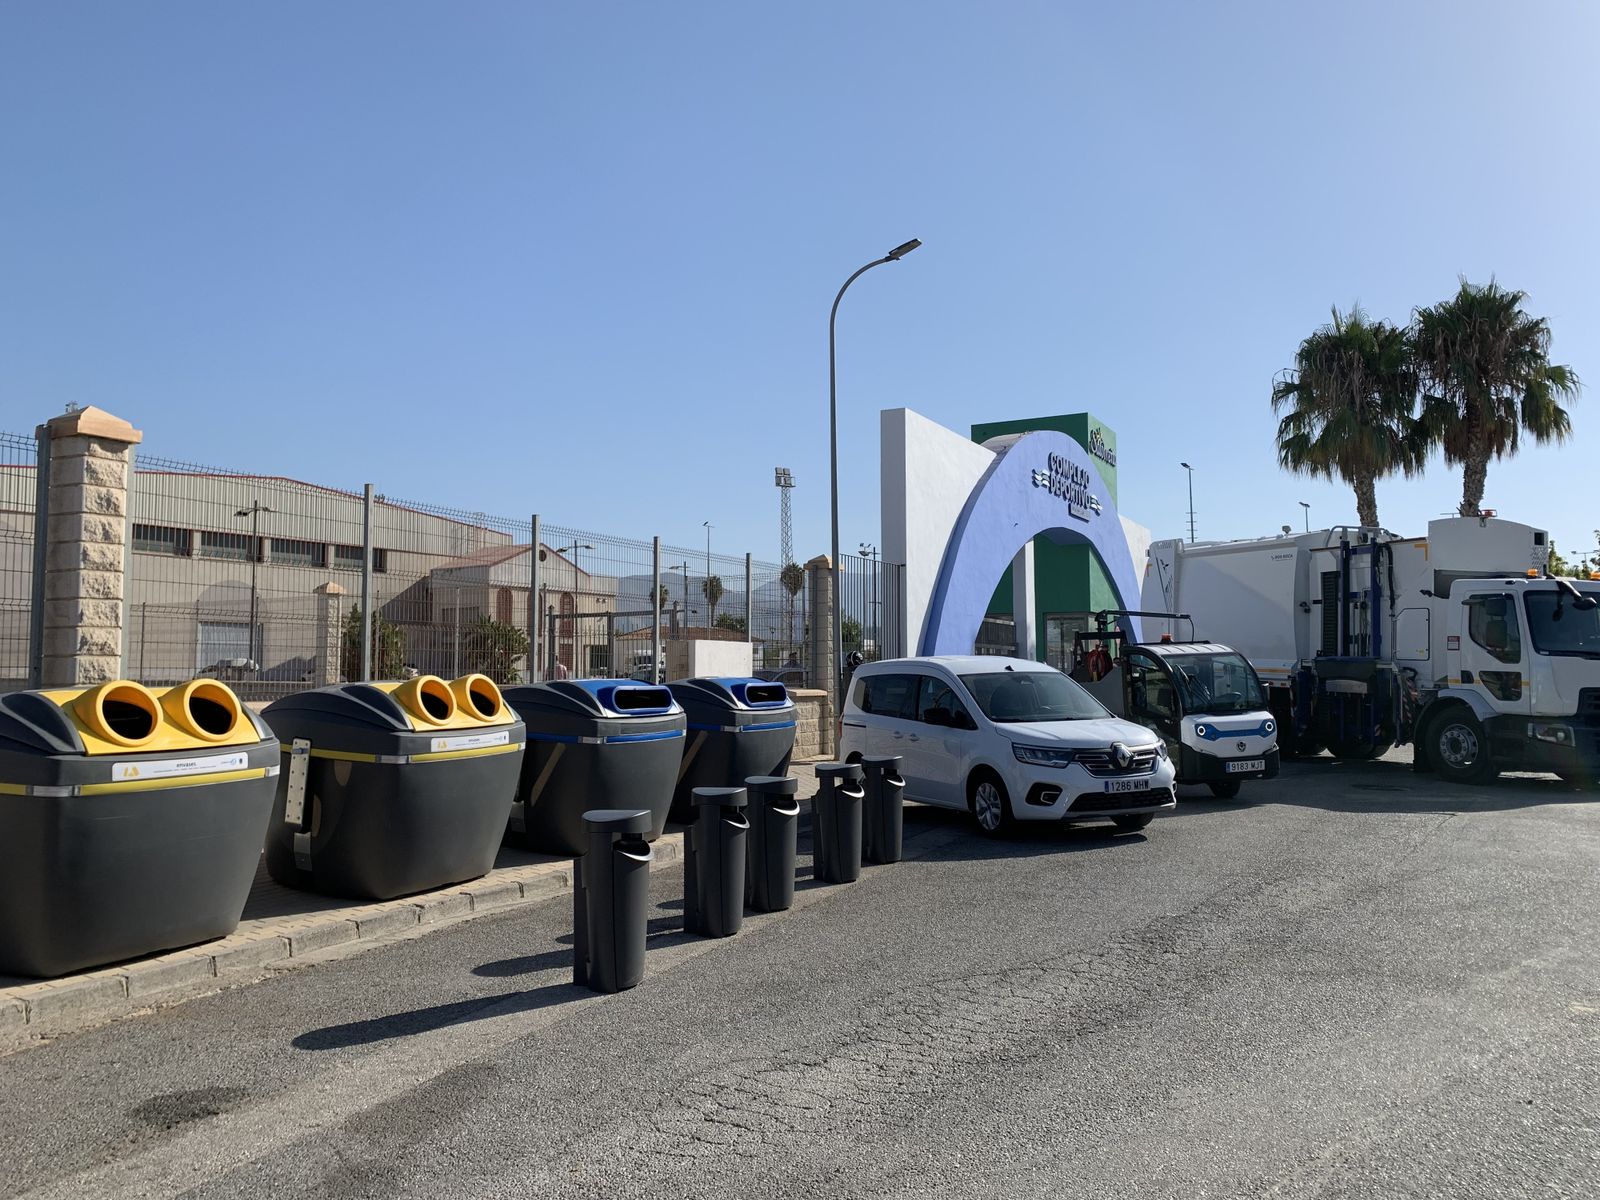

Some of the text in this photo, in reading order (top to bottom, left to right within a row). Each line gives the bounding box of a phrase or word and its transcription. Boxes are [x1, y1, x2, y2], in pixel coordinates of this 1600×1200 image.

[1048, 452, 1089, 490] COMPLEJO
[1048, 474, 1091, 509] DEPORTIVO
[1231, 761, 1264, 771] 9183 MJT
[1111, 779, 1149, 791] 1286 MHW
